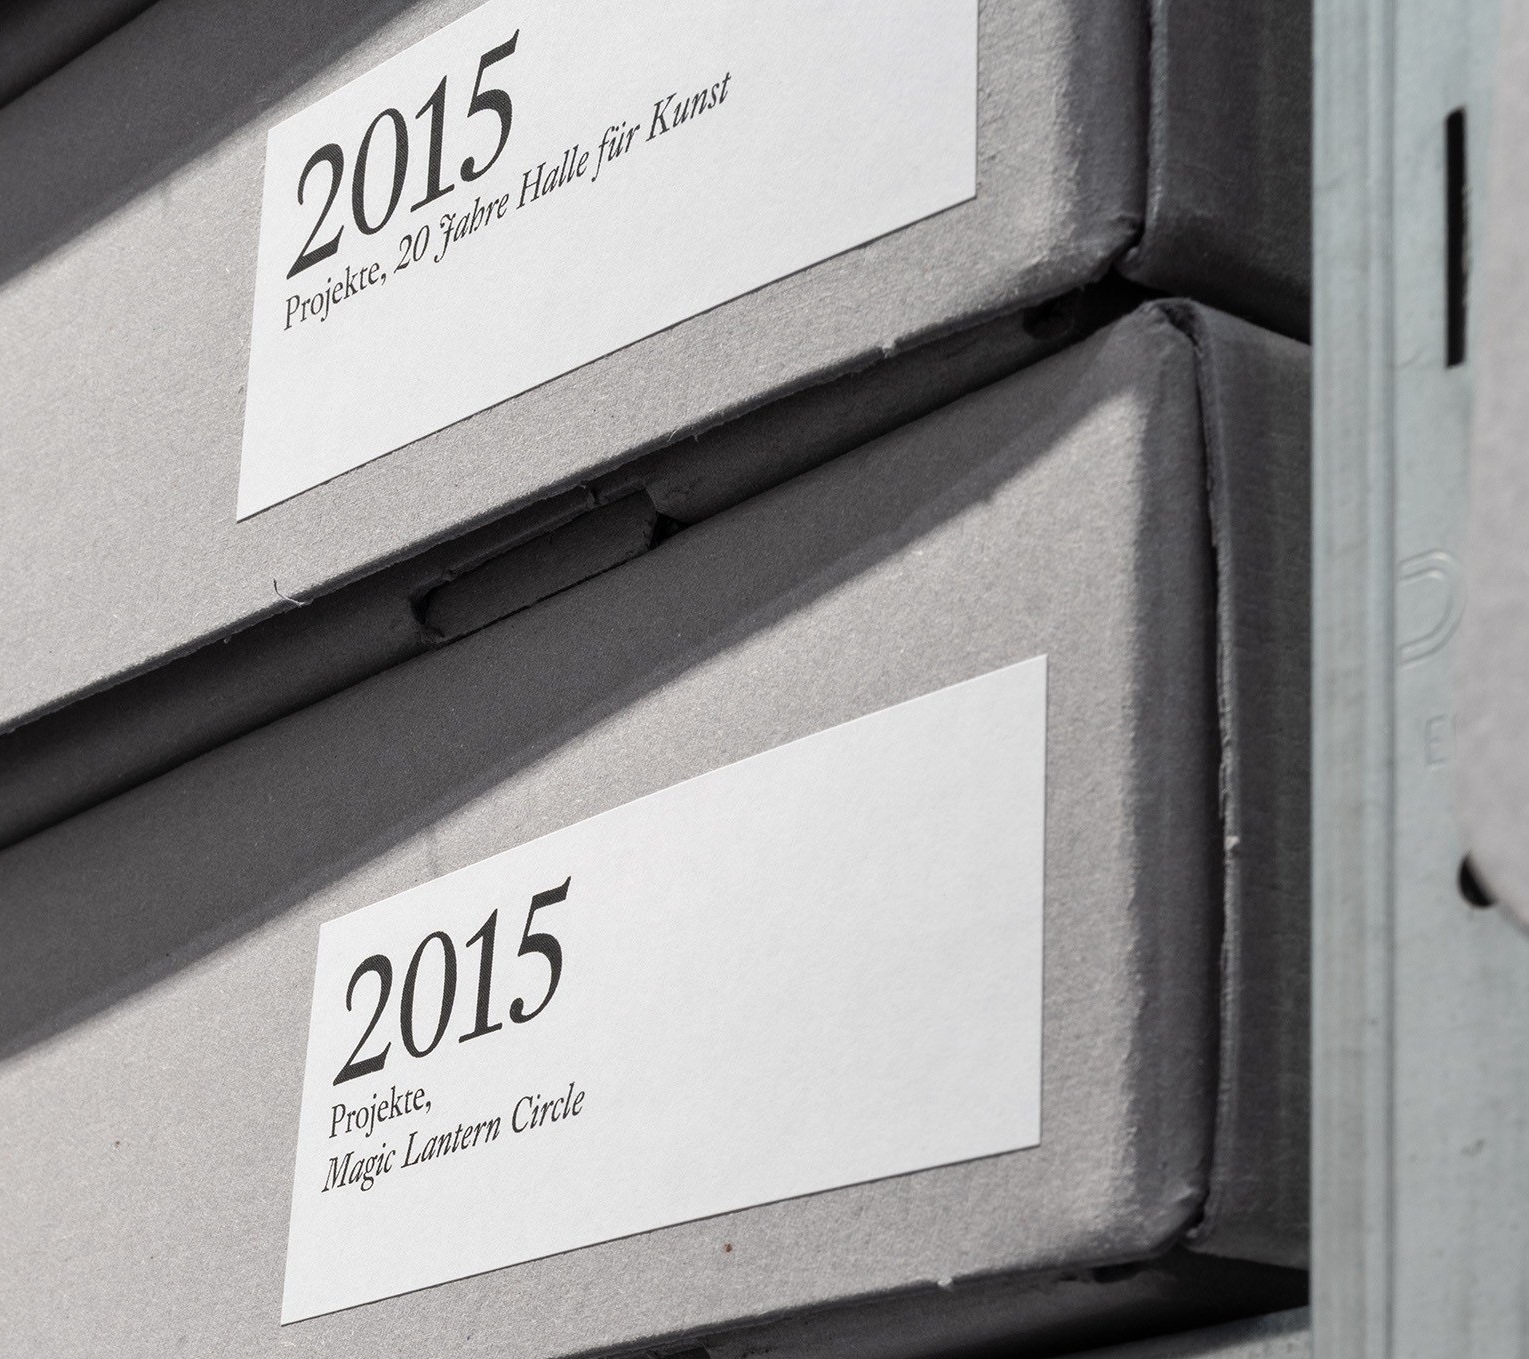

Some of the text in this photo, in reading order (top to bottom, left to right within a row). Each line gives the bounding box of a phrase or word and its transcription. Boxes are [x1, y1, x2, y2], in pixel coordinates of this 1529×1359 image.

[283, 71, 734, 331] Projekte, 20 Jahre Halle für Kunst
[285, 29, 520, 279] 2015
[331, 875, 572, 1087] 2015
[321, 1083, 587, 1194] Magic Lantern Circle
[327, 1084, 432, 1141] Projekte,
